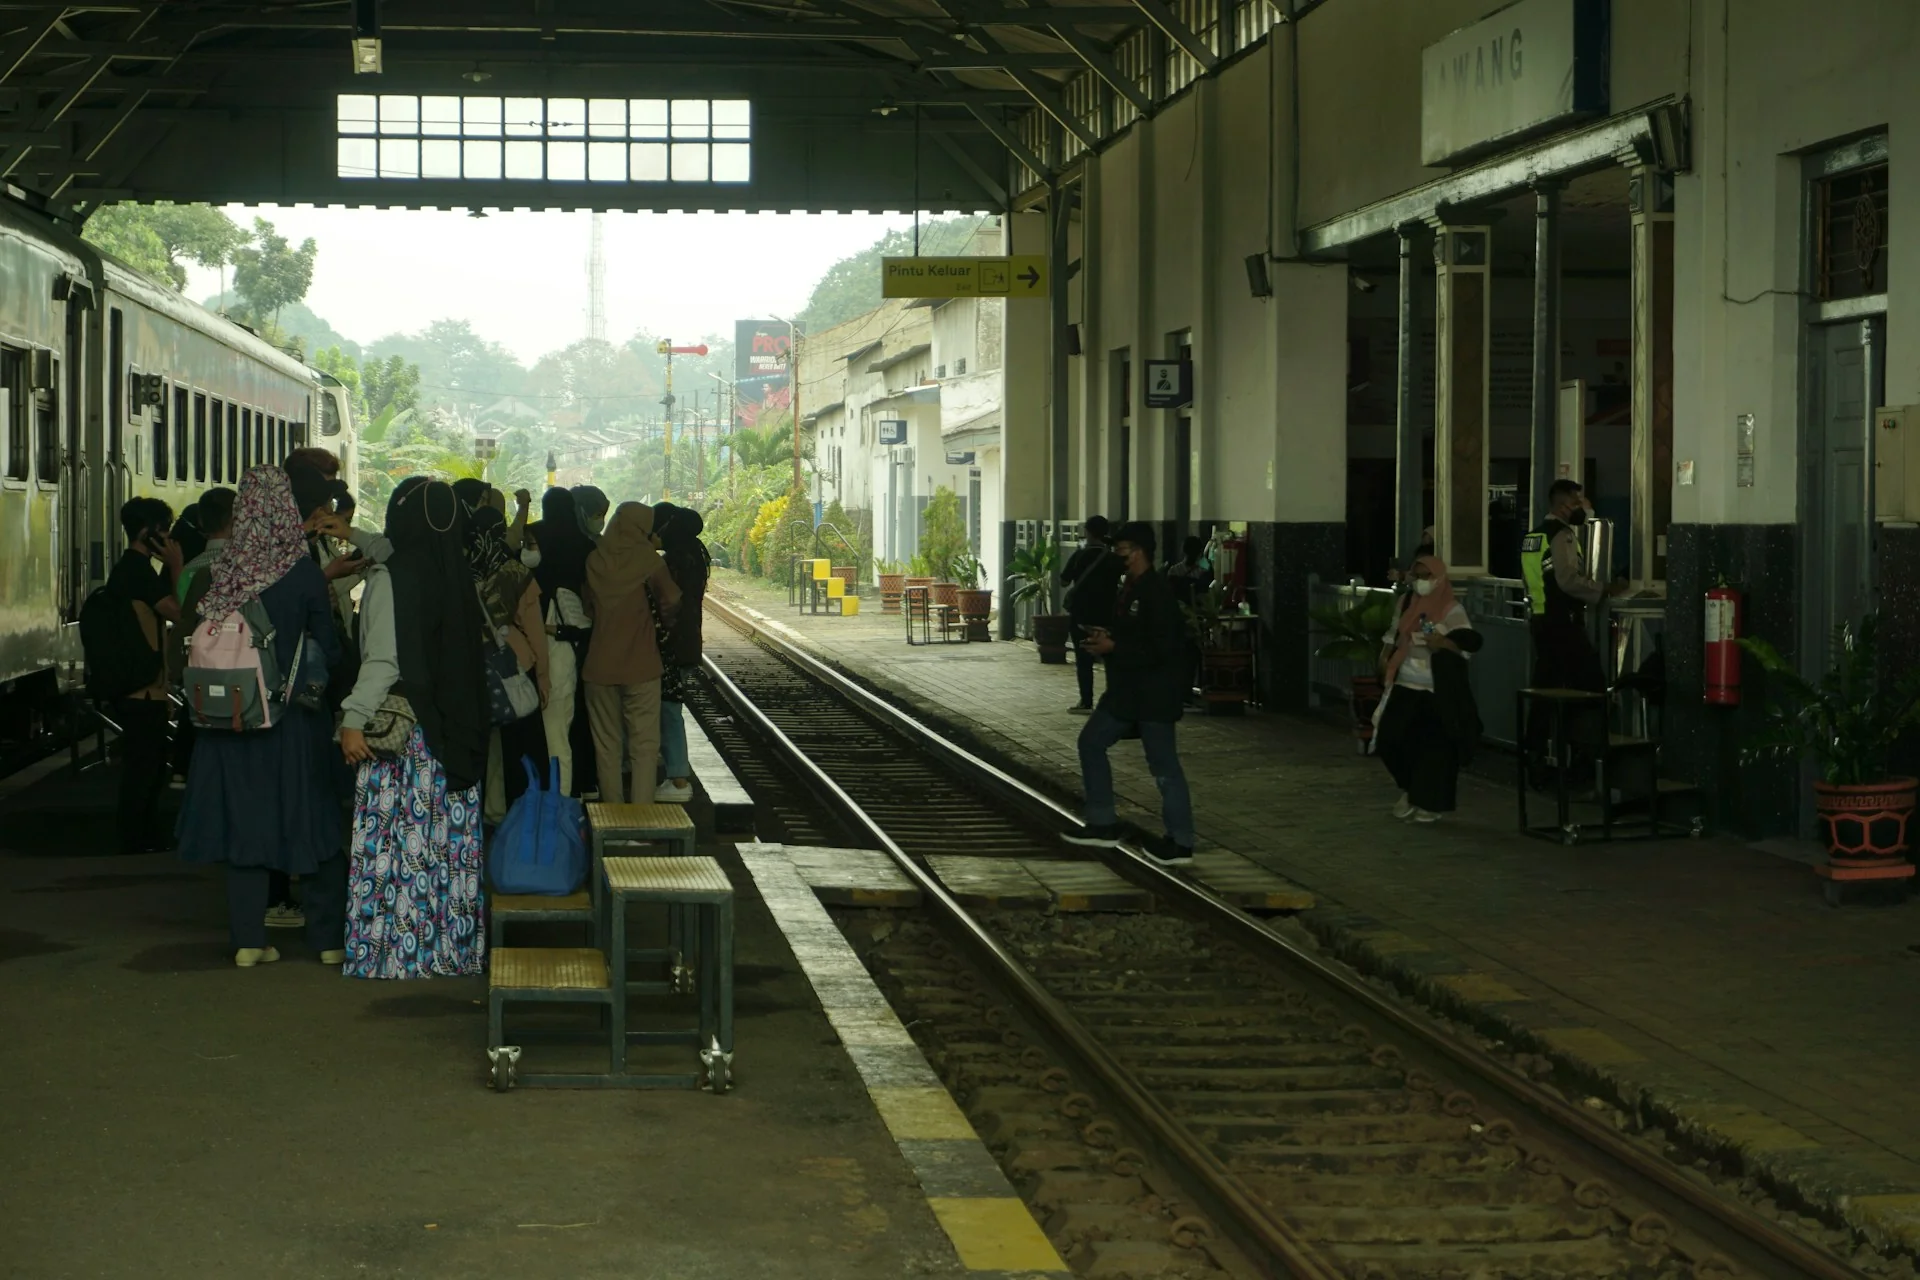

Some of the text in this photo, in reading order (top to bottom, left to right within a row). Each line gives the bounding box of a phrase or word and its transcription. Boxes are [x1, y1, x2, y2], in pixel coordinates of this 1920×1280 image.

[889, 265, 971, 277] Pintu Keluar
[753, 335, 790, 353] PRO
